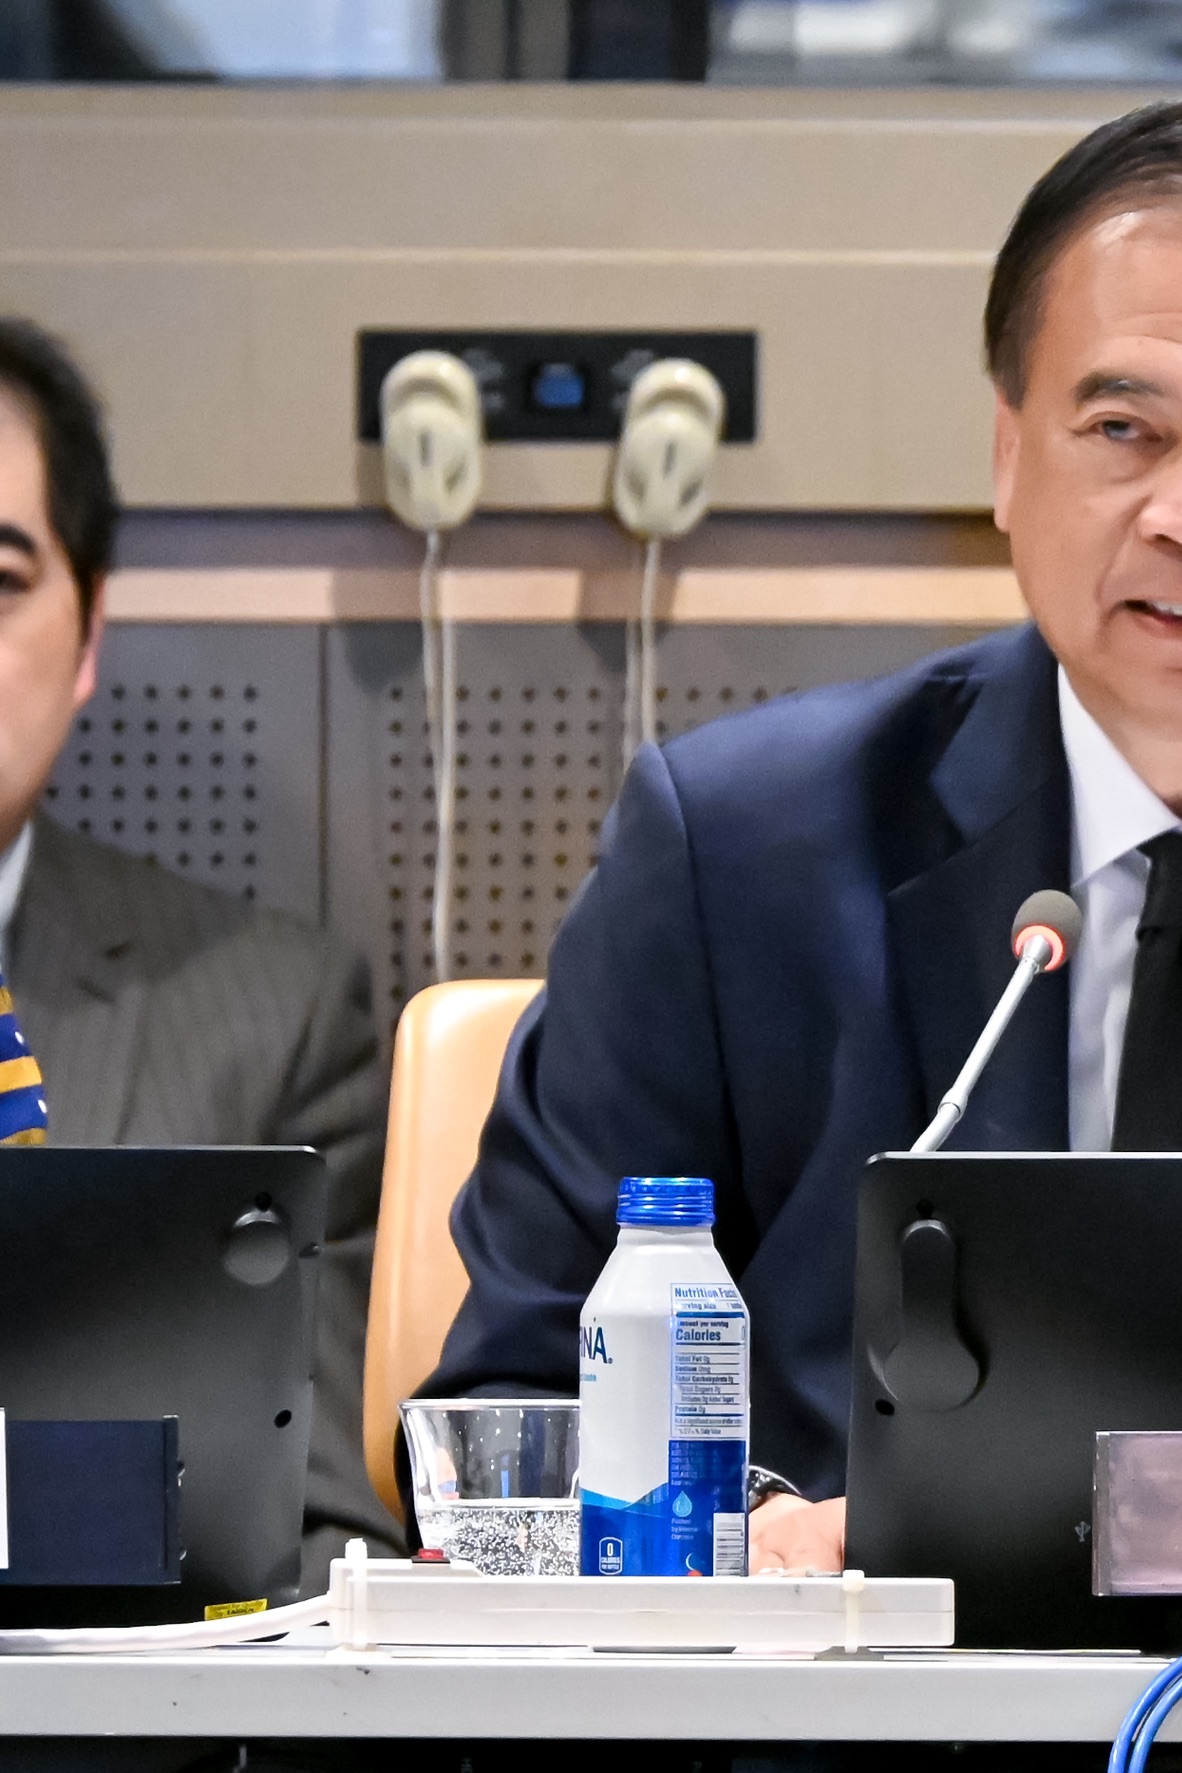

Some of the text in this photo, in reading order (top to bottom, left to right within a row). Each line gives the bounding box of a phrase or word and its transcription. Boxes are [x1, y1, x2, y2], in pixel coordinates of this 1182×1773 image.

[675, 1287, 718, 1298] Nutrition
[675, 1328, 721, 1341] Calories
[607, 1542, 613, 1556] 0
